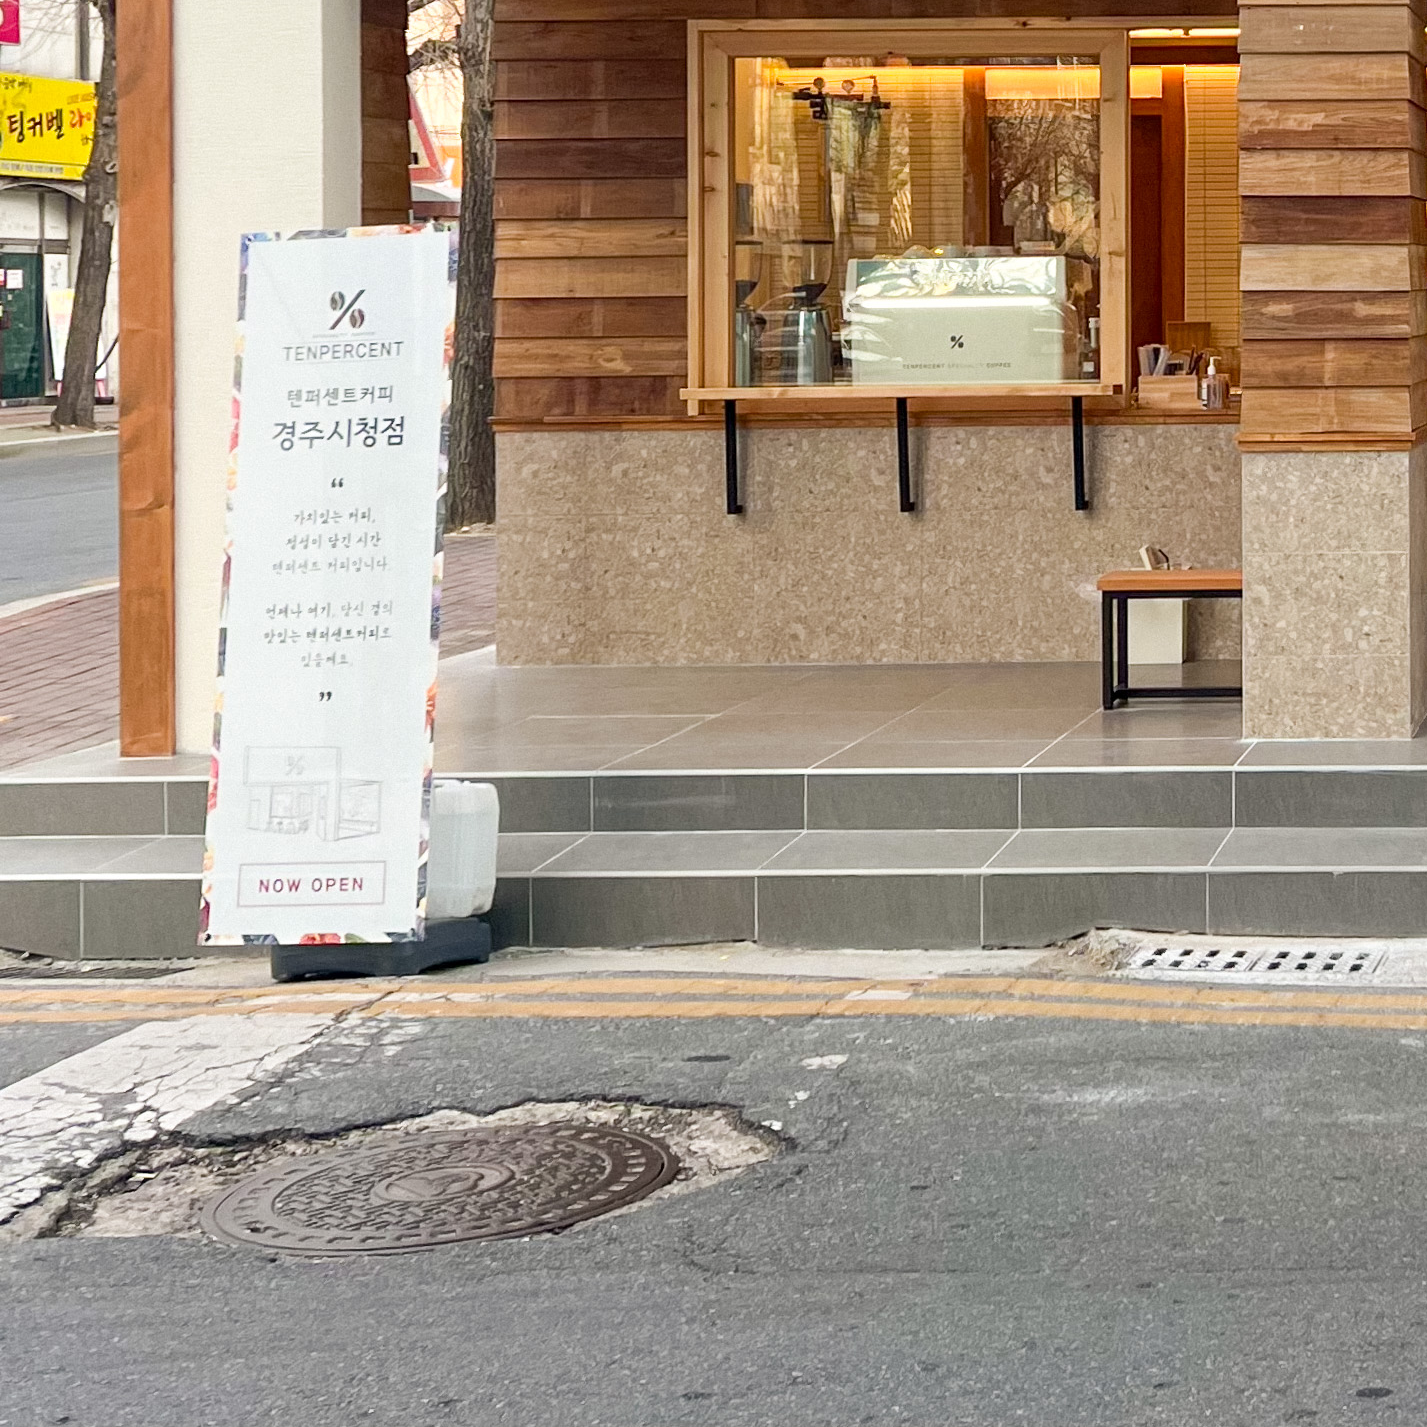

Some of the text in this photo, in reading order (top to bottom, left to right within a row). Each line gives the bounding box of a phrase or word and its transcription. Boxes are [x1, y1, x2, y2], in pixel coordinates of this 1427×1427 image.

[7, 108, 65, 143] 팅커벨
[282, 341, 405, 362] TENPERCENT
[287, 385, 394, 408] 텐퍼센트커피
[271, 415, 405, 452] 경주시청점
[356, 531, 382, 548] 시간
[259, 877, 364, 893] NOW OPEN
